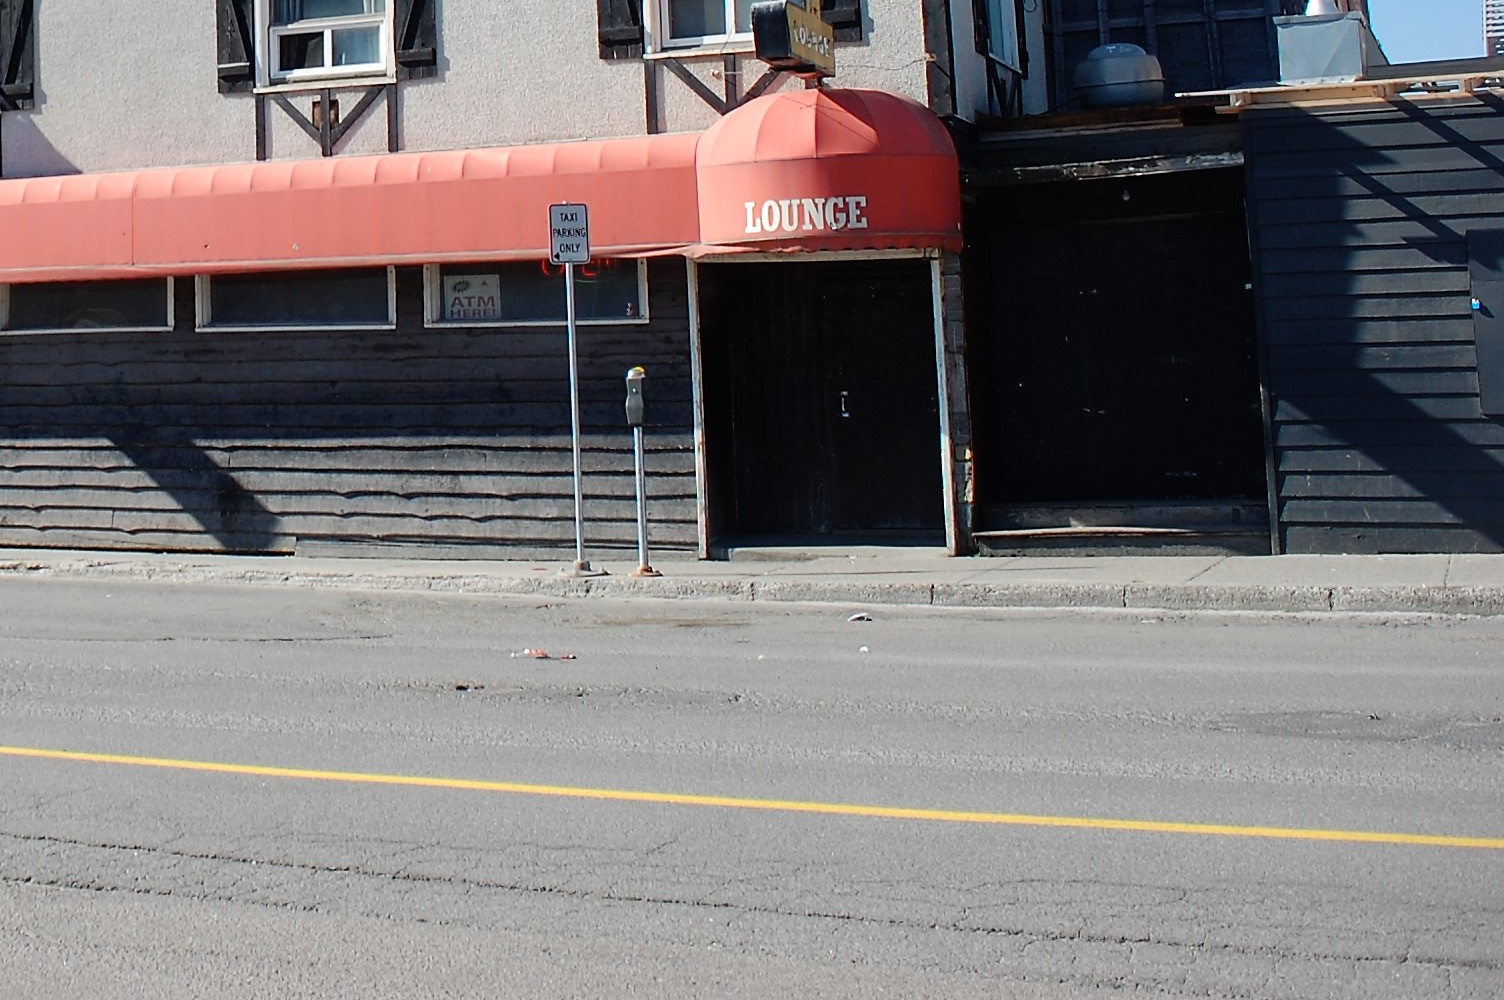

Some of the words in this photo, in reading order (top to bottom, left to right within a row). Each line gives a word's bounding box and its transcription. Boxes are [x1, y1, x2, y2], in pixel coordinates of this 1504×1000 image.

[560, 212, 578, 222] TAXI
[744, 195, 868, 234] LOUNGE
[553, 227, 587, 238] PARKING
[559, 243, 581, 253] ONLY
[451, 295, 496, 308] ATM
